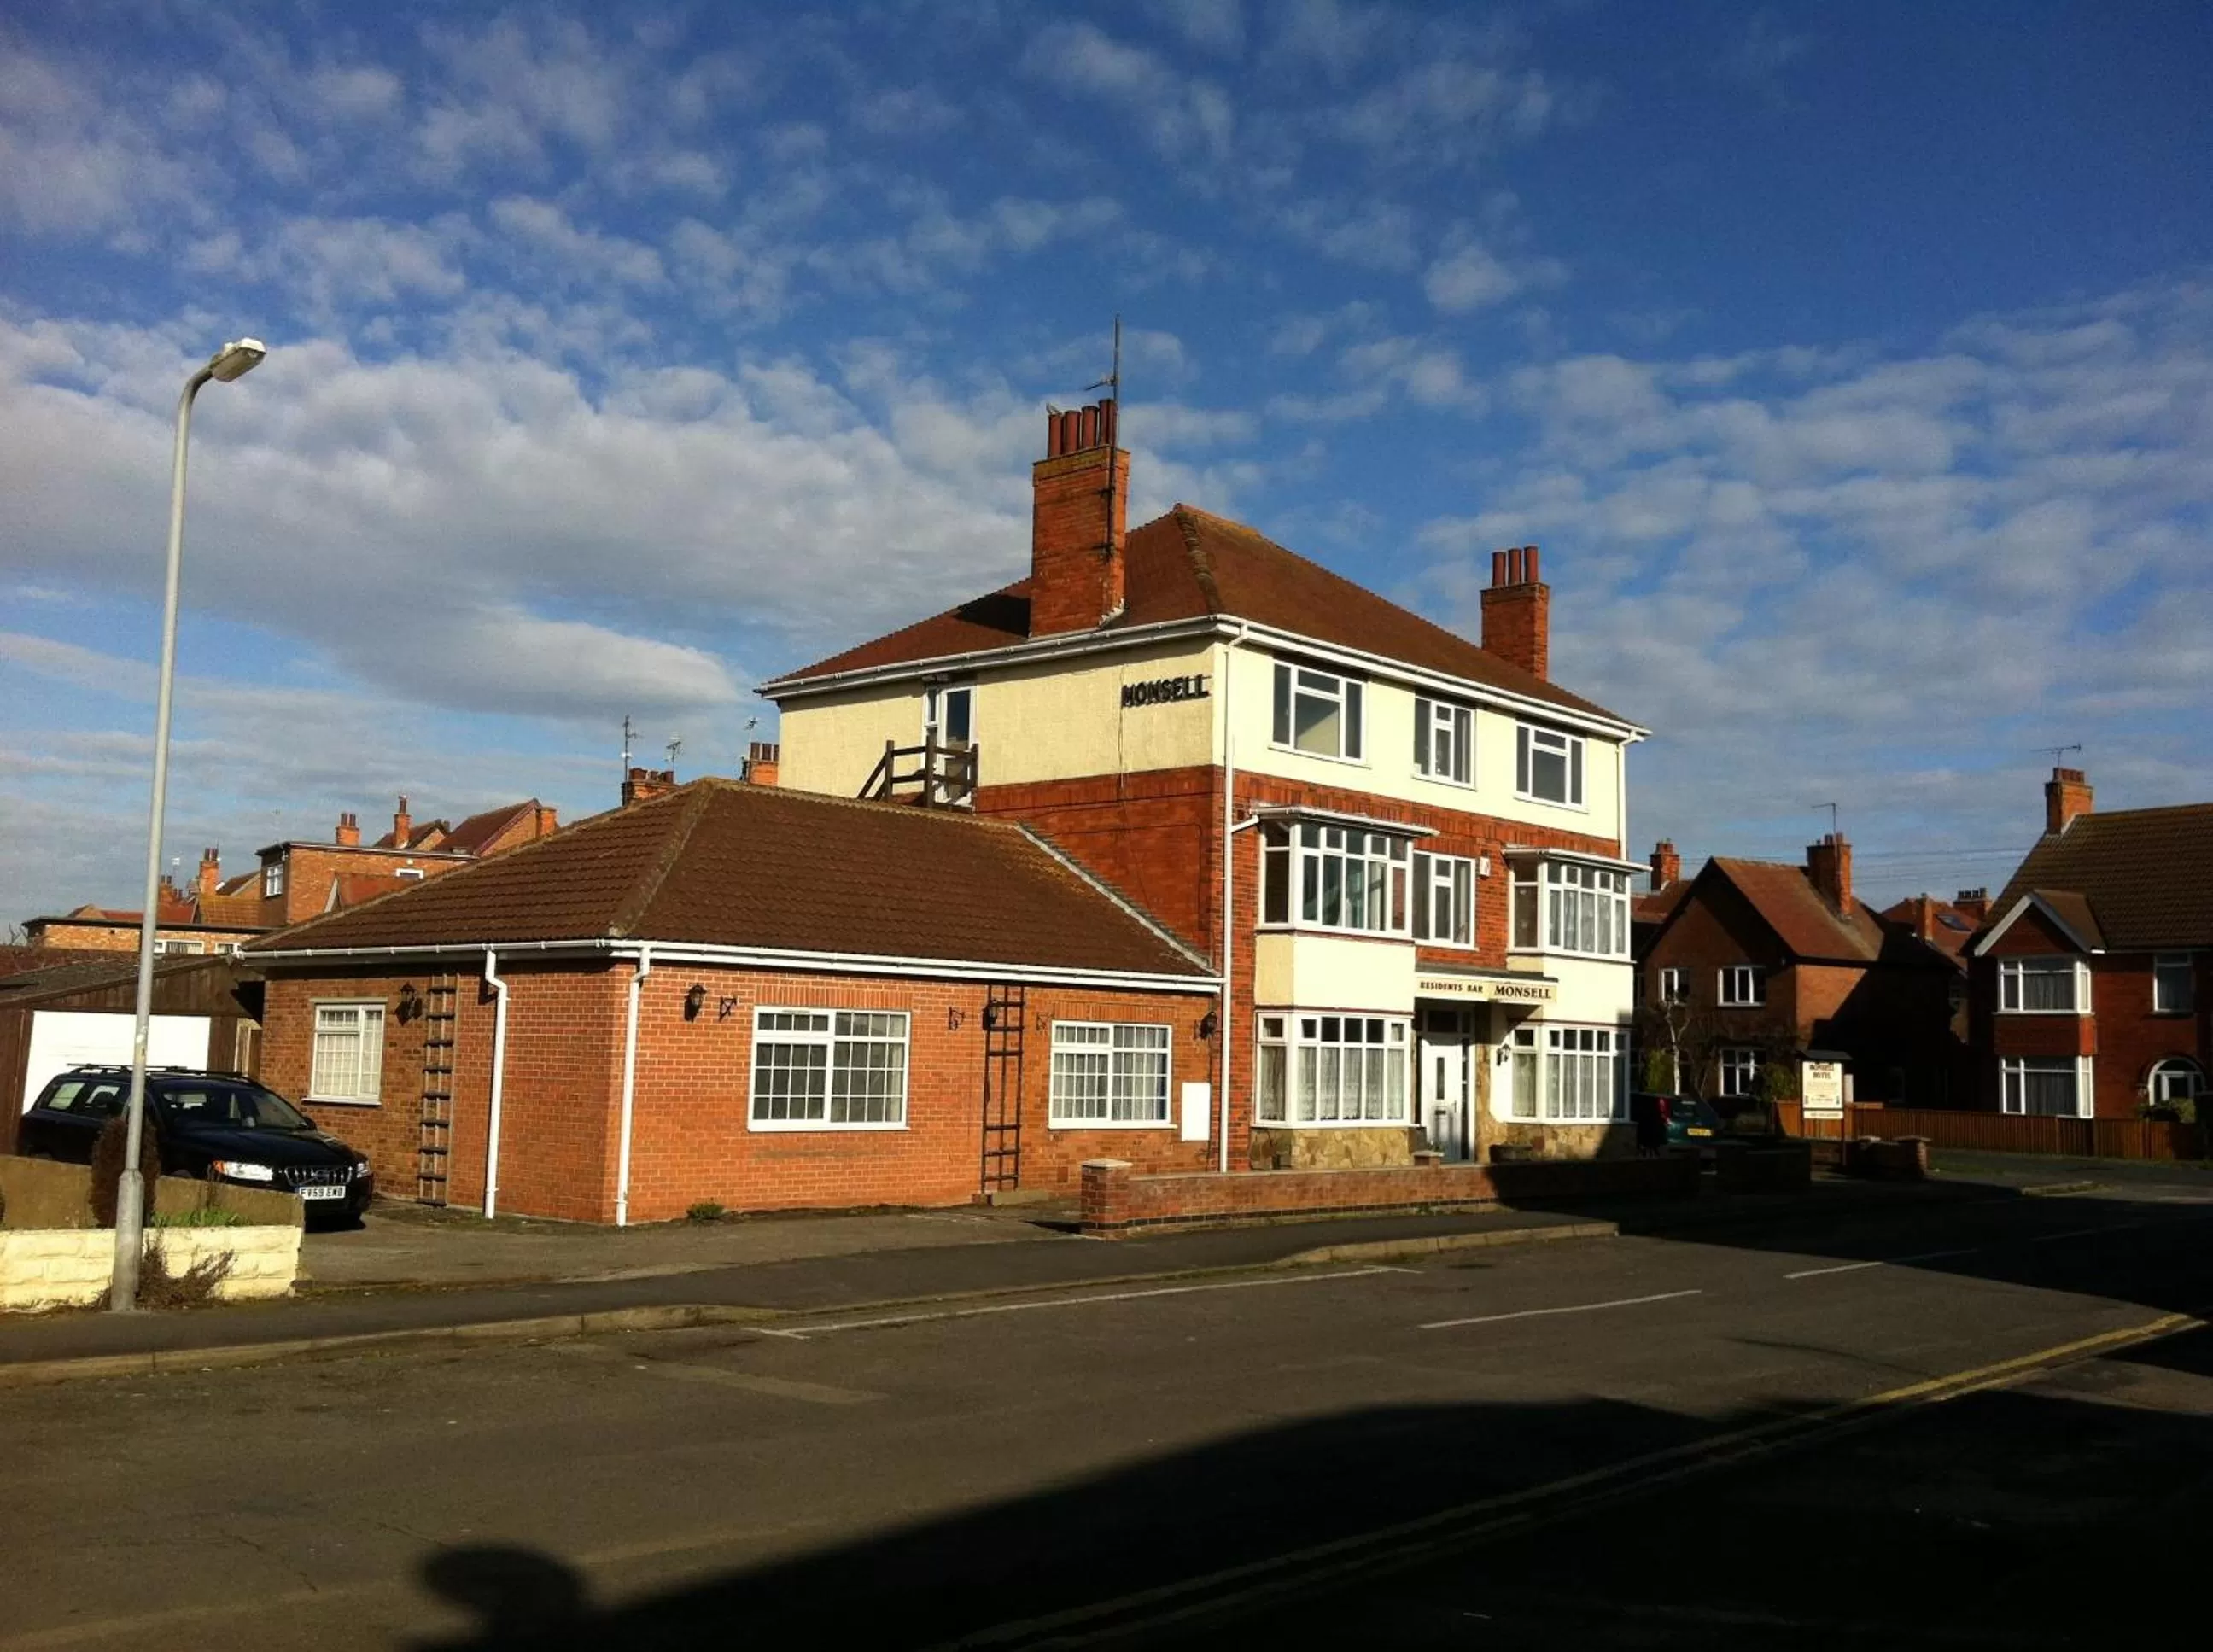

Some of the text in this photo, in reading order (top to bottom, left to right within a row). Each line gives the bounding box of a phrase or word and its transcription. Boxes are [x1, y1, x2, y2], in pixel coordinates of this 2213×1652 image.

[1121, 674, 1211, 708] MONSELL
[1420, 982, 1483, 993] RESIDENTS BAR
[1494, 984, 1551, 1000] MONSELL
